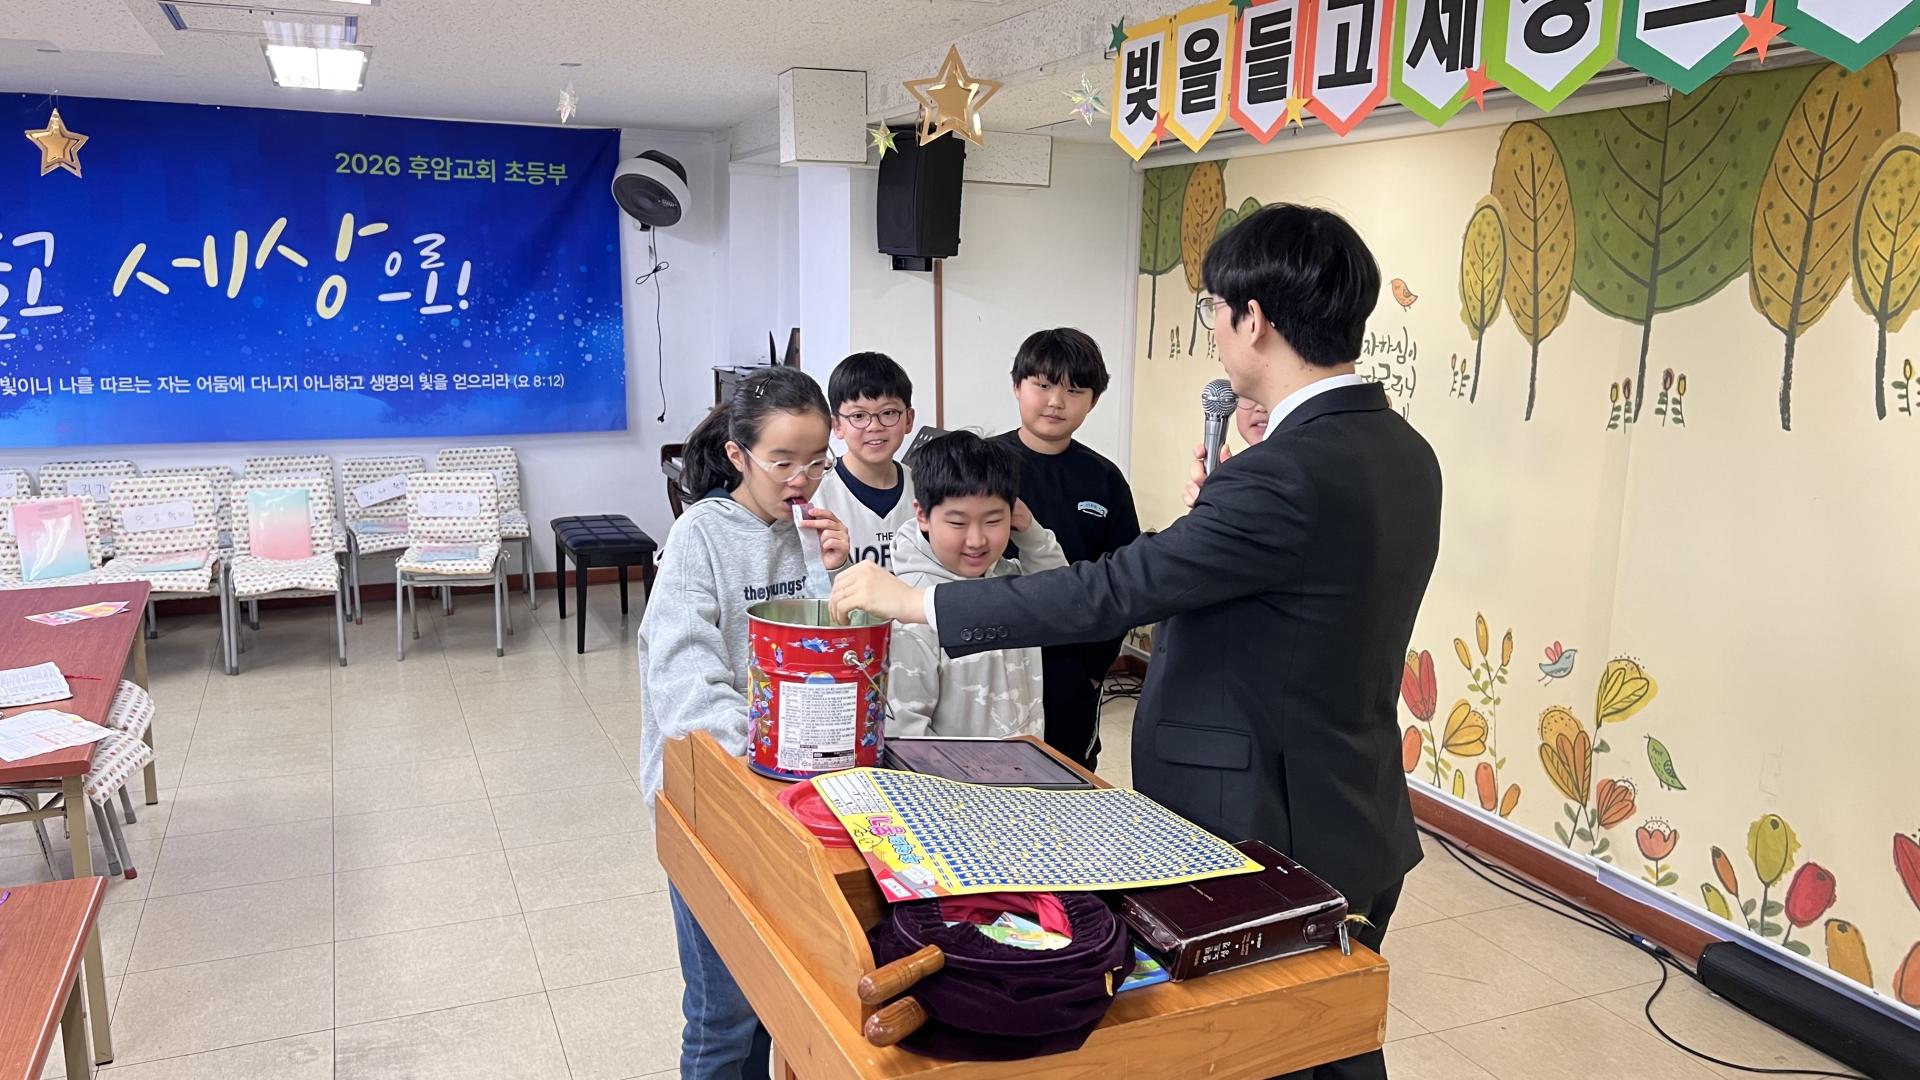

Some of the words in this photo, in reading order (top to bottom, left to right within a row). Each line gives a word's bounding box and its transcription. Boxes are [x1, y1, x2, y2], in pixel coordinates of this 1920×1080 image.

[1125, 27, 1222, 125] 빛을
[1245, 0, 1375, 105] 들고
[335, 152, 401, 176] 2026
[408, 155, 497, 183] 후암교회
[504, 160, 569, 186] 초등부
[112, 212, 472, 321] 세상으로!
[59, 376, 95, 394] 나를
[100, 376, 152, 394] 따르는
[157, 375, 191, 394] 자는
[196, 375, 246, 393] 어둠에
[251, 375, 299, 393] 다니지
[303, 374, 365, 392] 아니하고
[369, 374, 415, 392] 생명의
[419, 373, 448, 391] 빛을
[453, 373, 510, 391] 얻으리라
[513, 373, 531, 390] (요
[533, 373, 565, 390] 8:12)
[876, 531, 894, 542] THE
